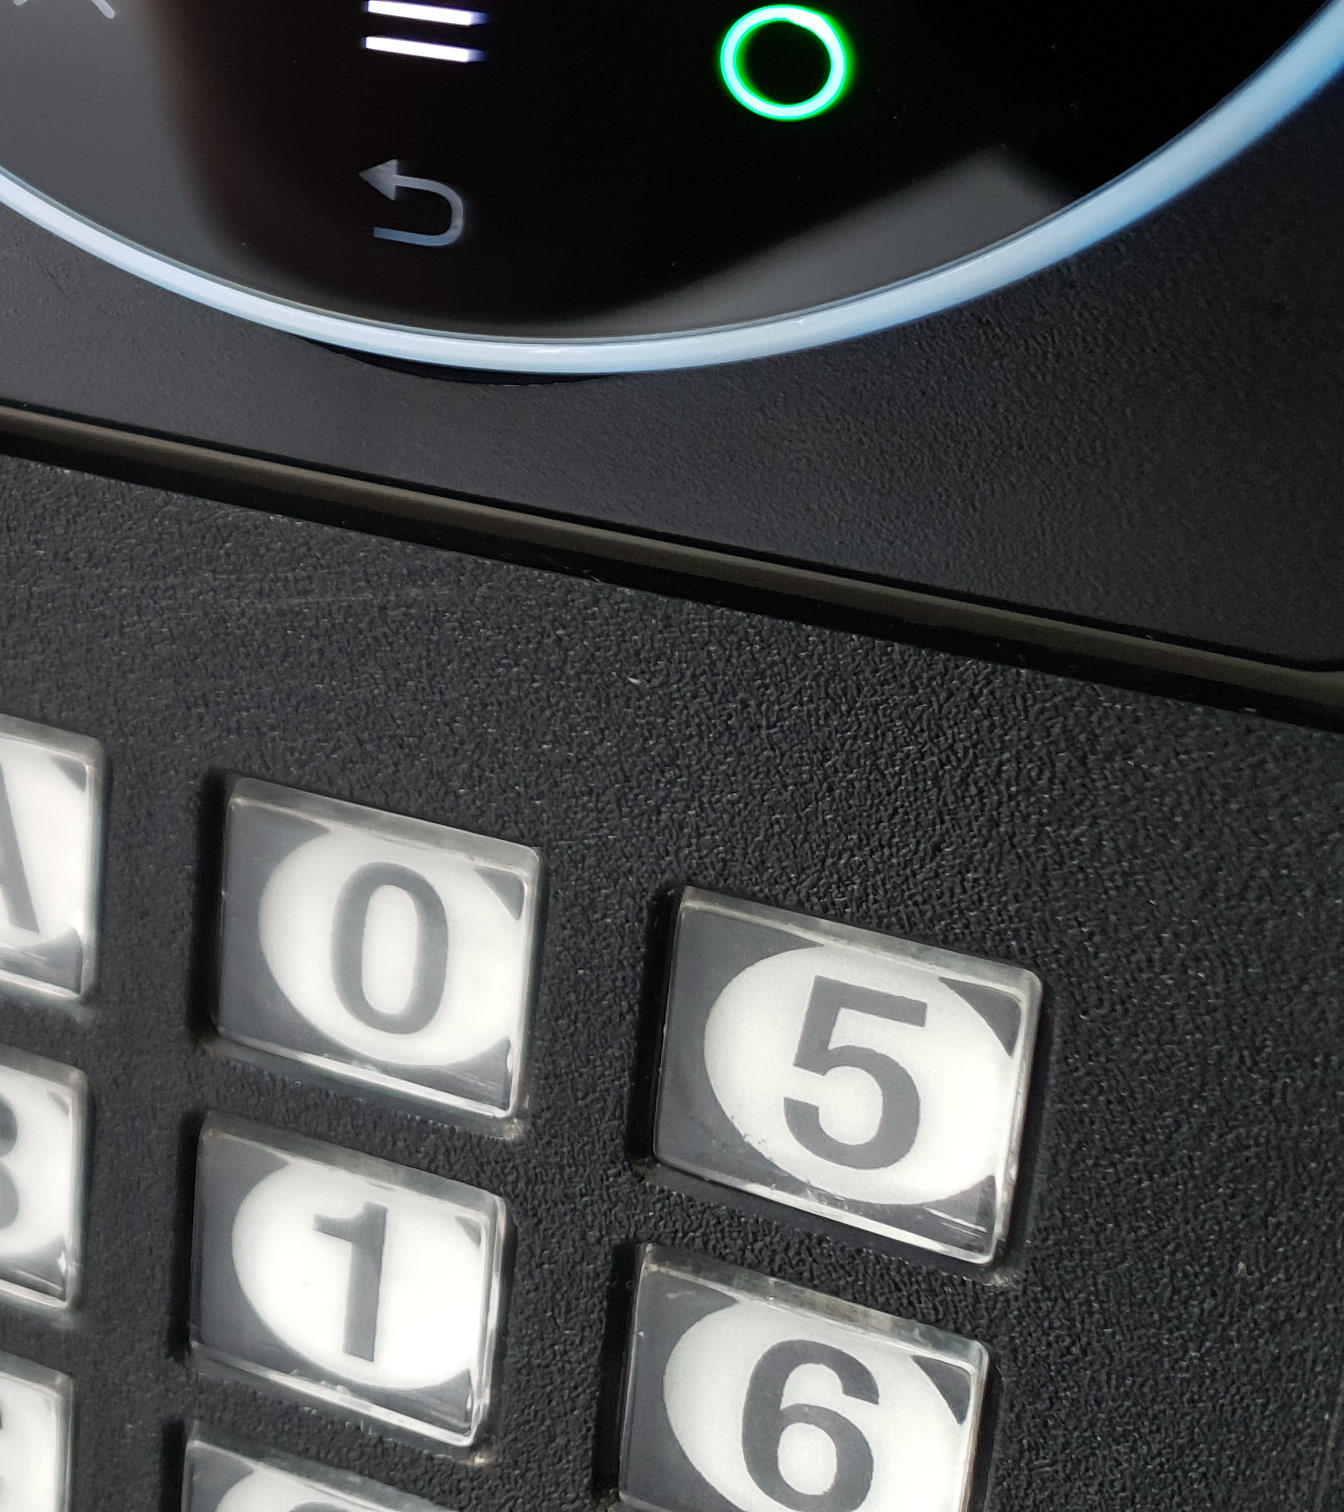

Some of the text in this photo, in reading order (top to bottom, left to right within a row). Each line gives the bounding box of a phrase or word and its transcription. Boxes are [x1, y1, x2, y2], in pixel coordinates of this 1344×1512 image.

[330, 861, 449, 1036] 0
[783, 974, 928, 1170] 5
[312, 1201, 389, 1363] 1
[741, 1339, 880, 1512] 6
